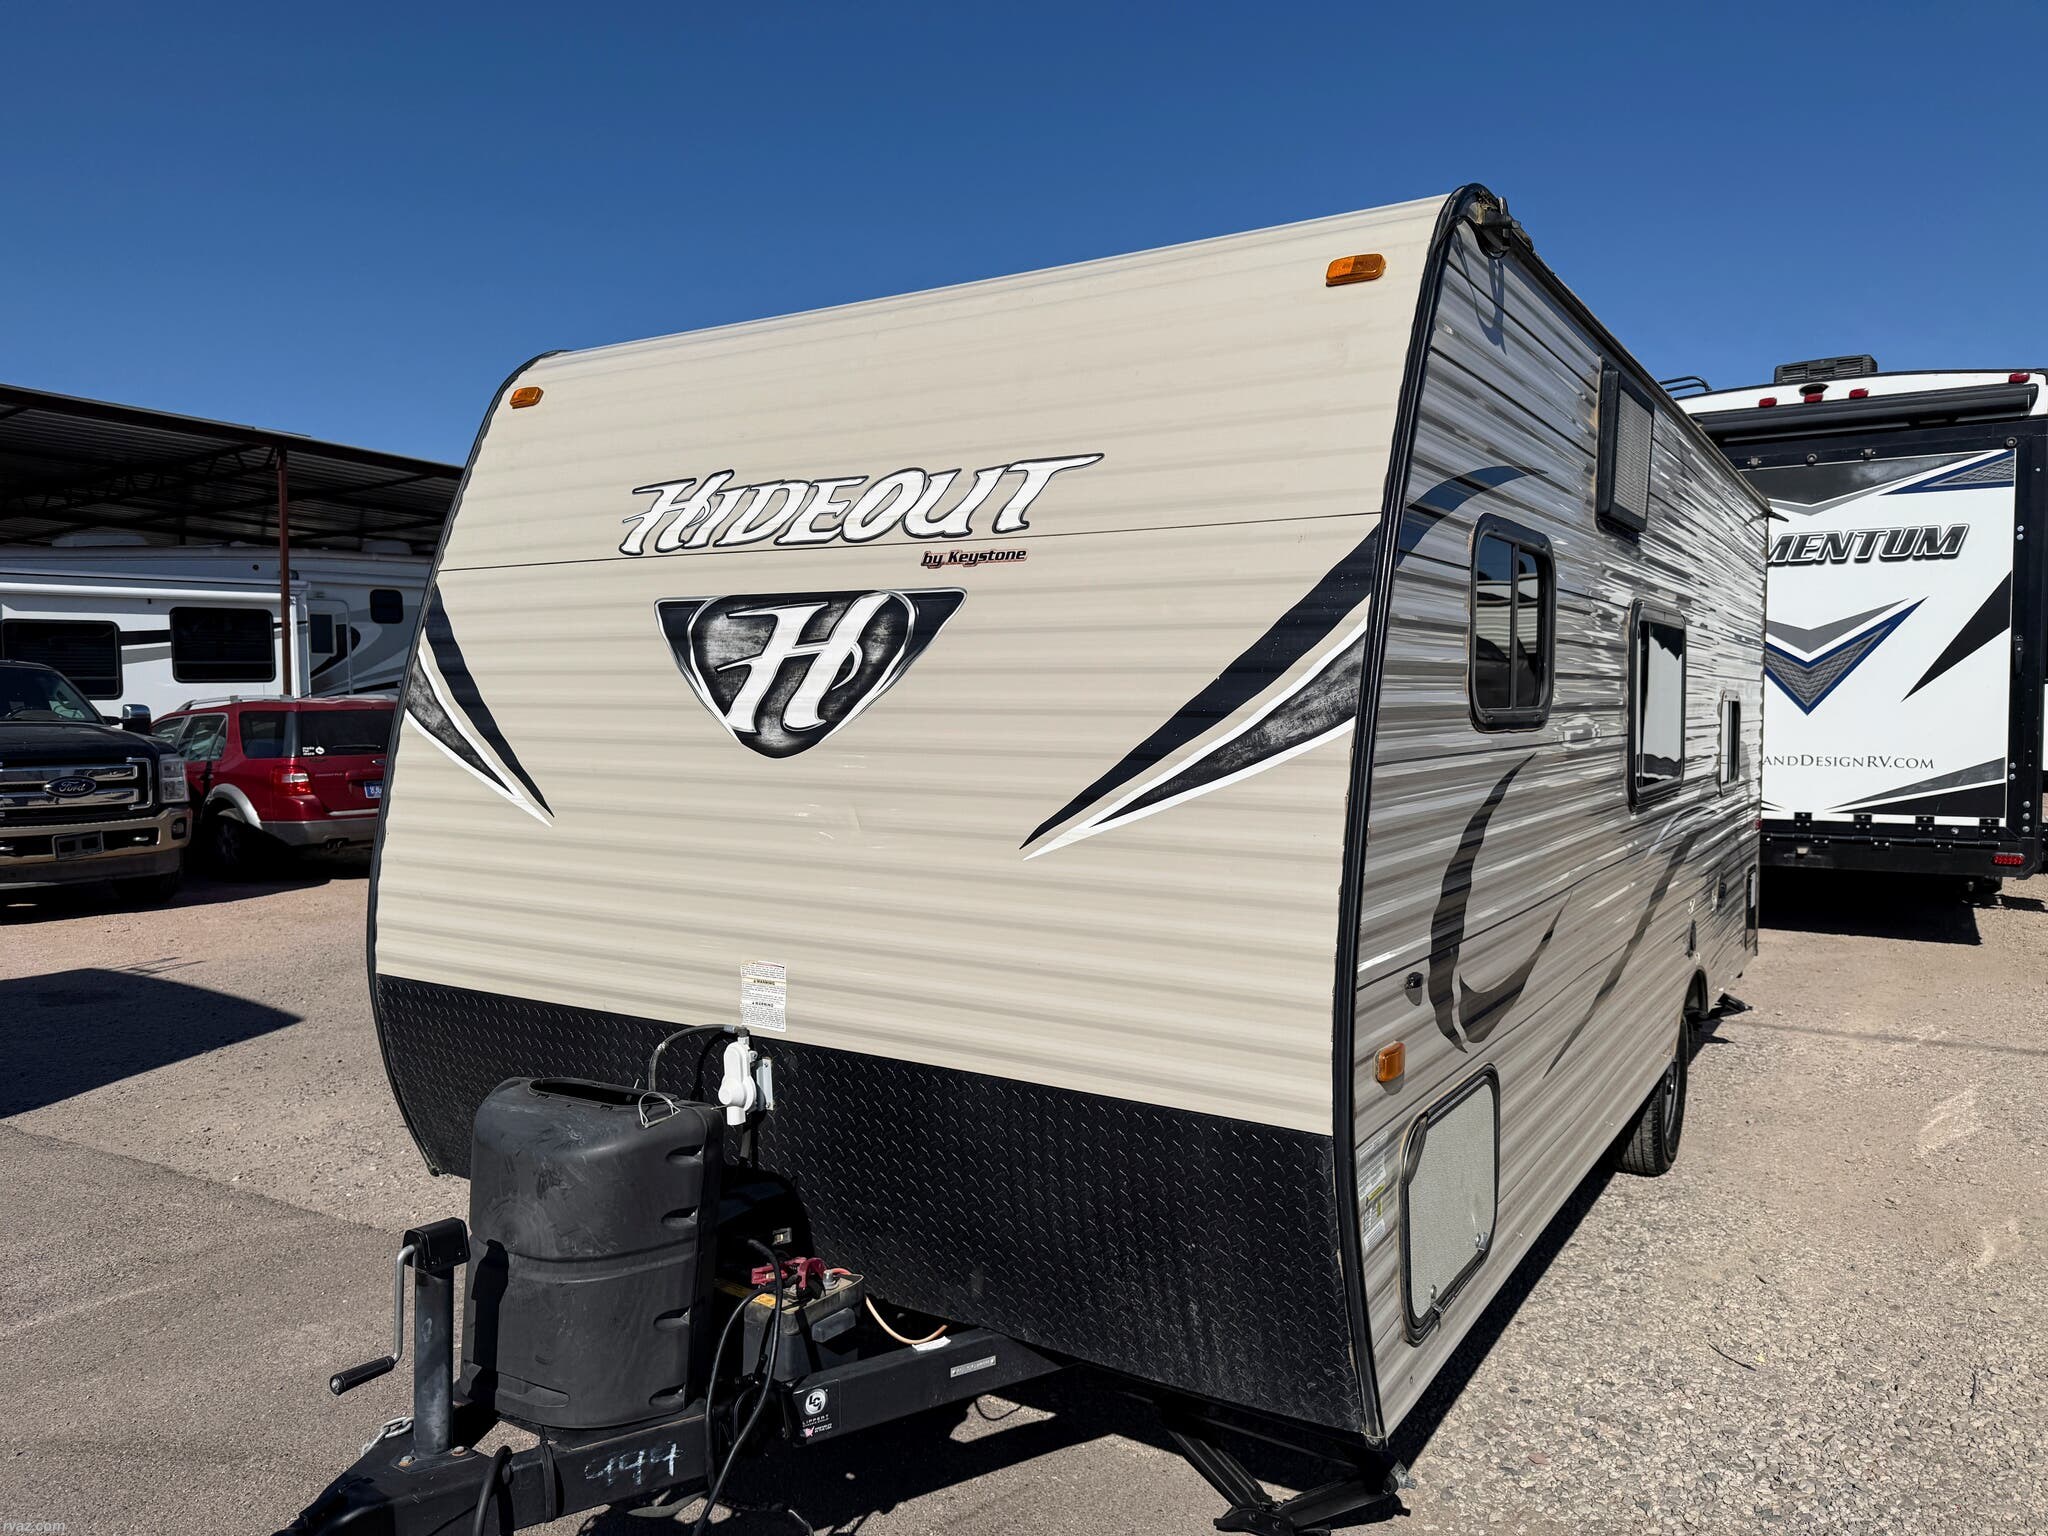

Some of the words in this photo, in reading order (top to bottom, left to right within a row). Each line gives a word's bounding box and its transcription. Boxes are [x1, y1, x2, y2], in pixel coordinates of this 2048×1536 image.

[619, 453, 1105, 556] HIDEOUT
[921, 551, 944, 569] by
[947, 548, 1028, 566] Keystone
[717, 593, 893, 734] H
[58, 781, 86, 792] Ford
